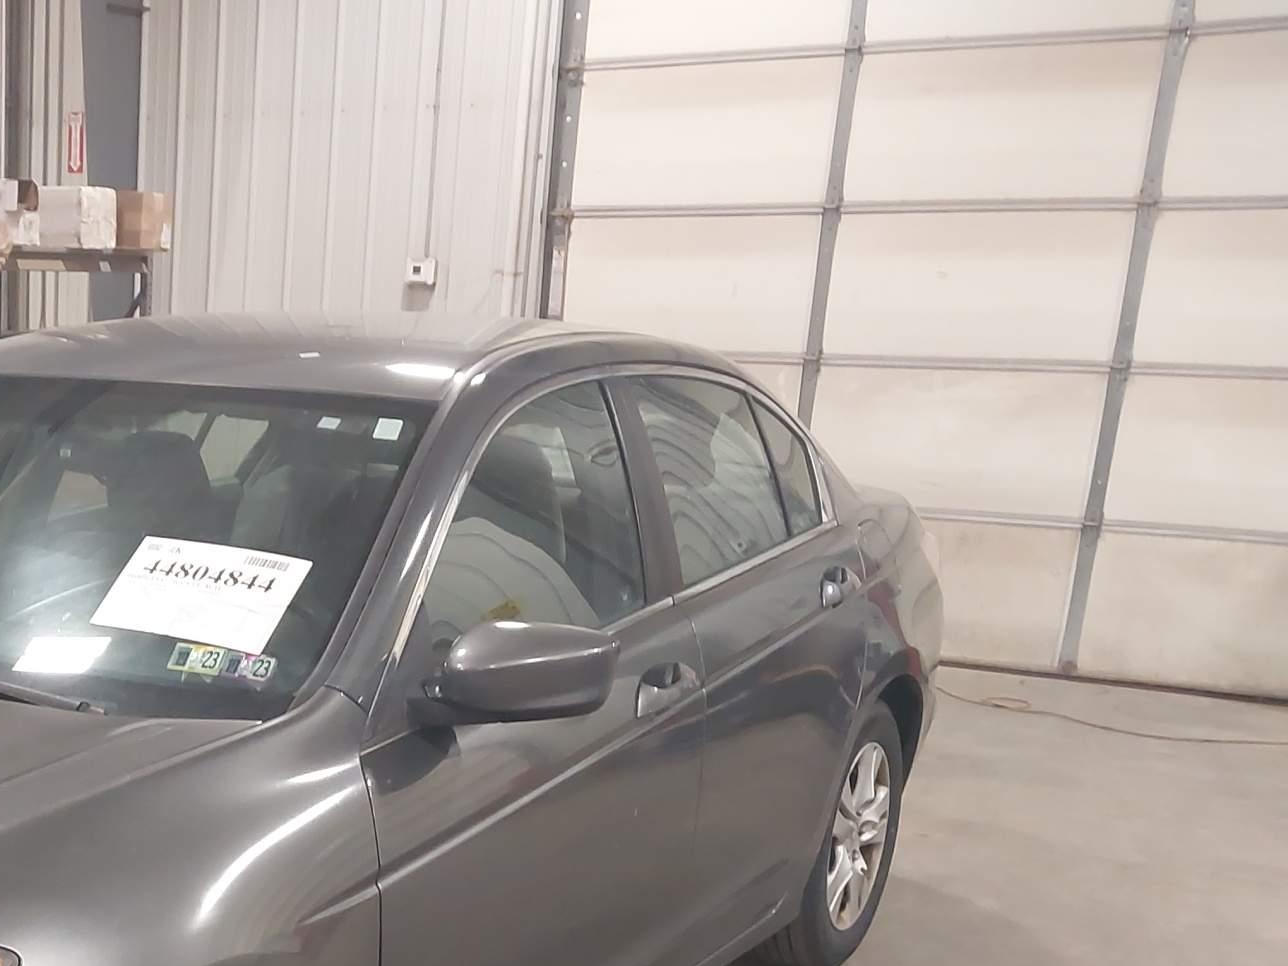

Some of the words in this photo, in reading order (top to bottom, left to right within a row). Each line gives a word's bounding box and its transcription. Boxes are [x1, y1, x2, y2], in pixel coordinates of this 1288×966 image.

[144, 559, 276, 593] 44804844
[201, 651, 220, 670] 23
[252, 659, 272, 678] 23
